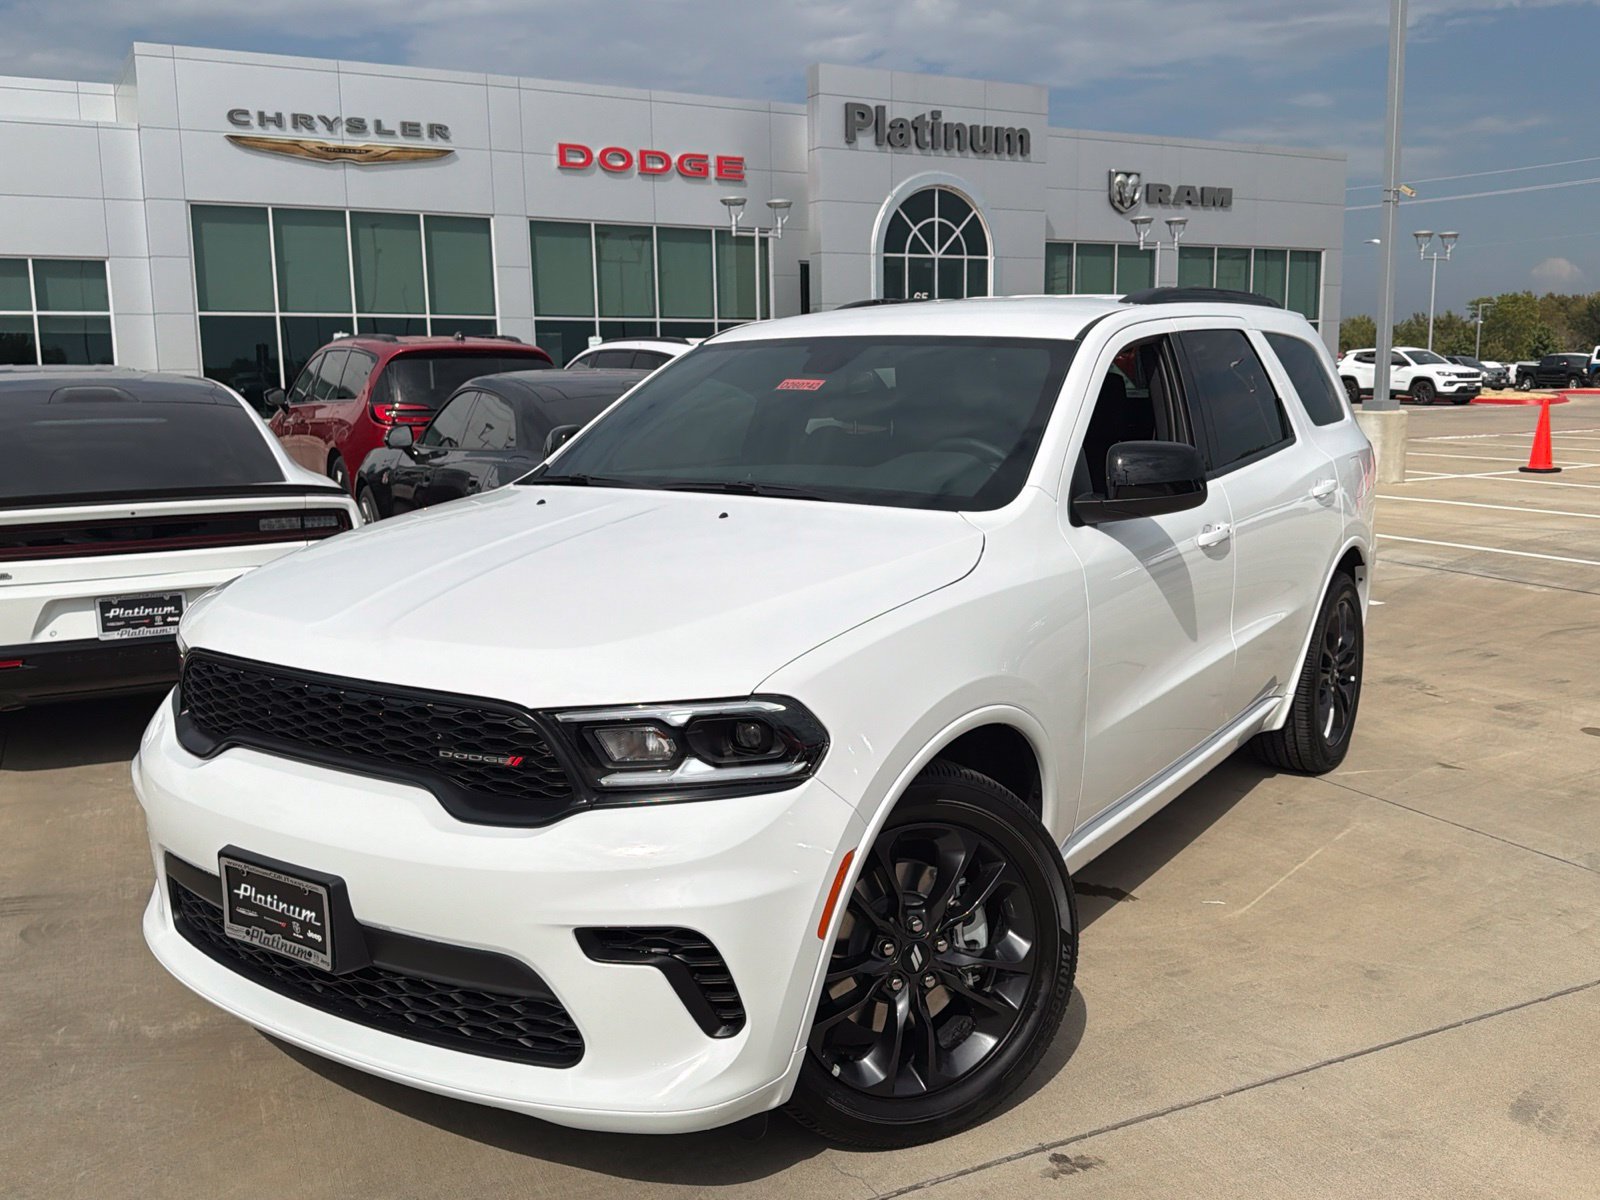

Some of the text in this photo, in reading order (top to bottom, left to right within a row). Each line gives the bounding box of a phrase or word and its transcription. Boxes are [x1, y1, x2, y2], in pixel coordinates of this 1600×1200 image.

[226, 108, 450, 139] CHRYSLER
[844, 102, 1031, 157] Platinum
[557, 142, 745, 181] DODGE
[1145, 183, 1233, 208] RAM
[104, 606, 178, 618] Platinum
[121, 627, 171, 637] Platinum
[439, 751, 510, 764] DODGE
[234, 883, 321, 926] Platinum
[250, 929, 311, 960] Platinum
